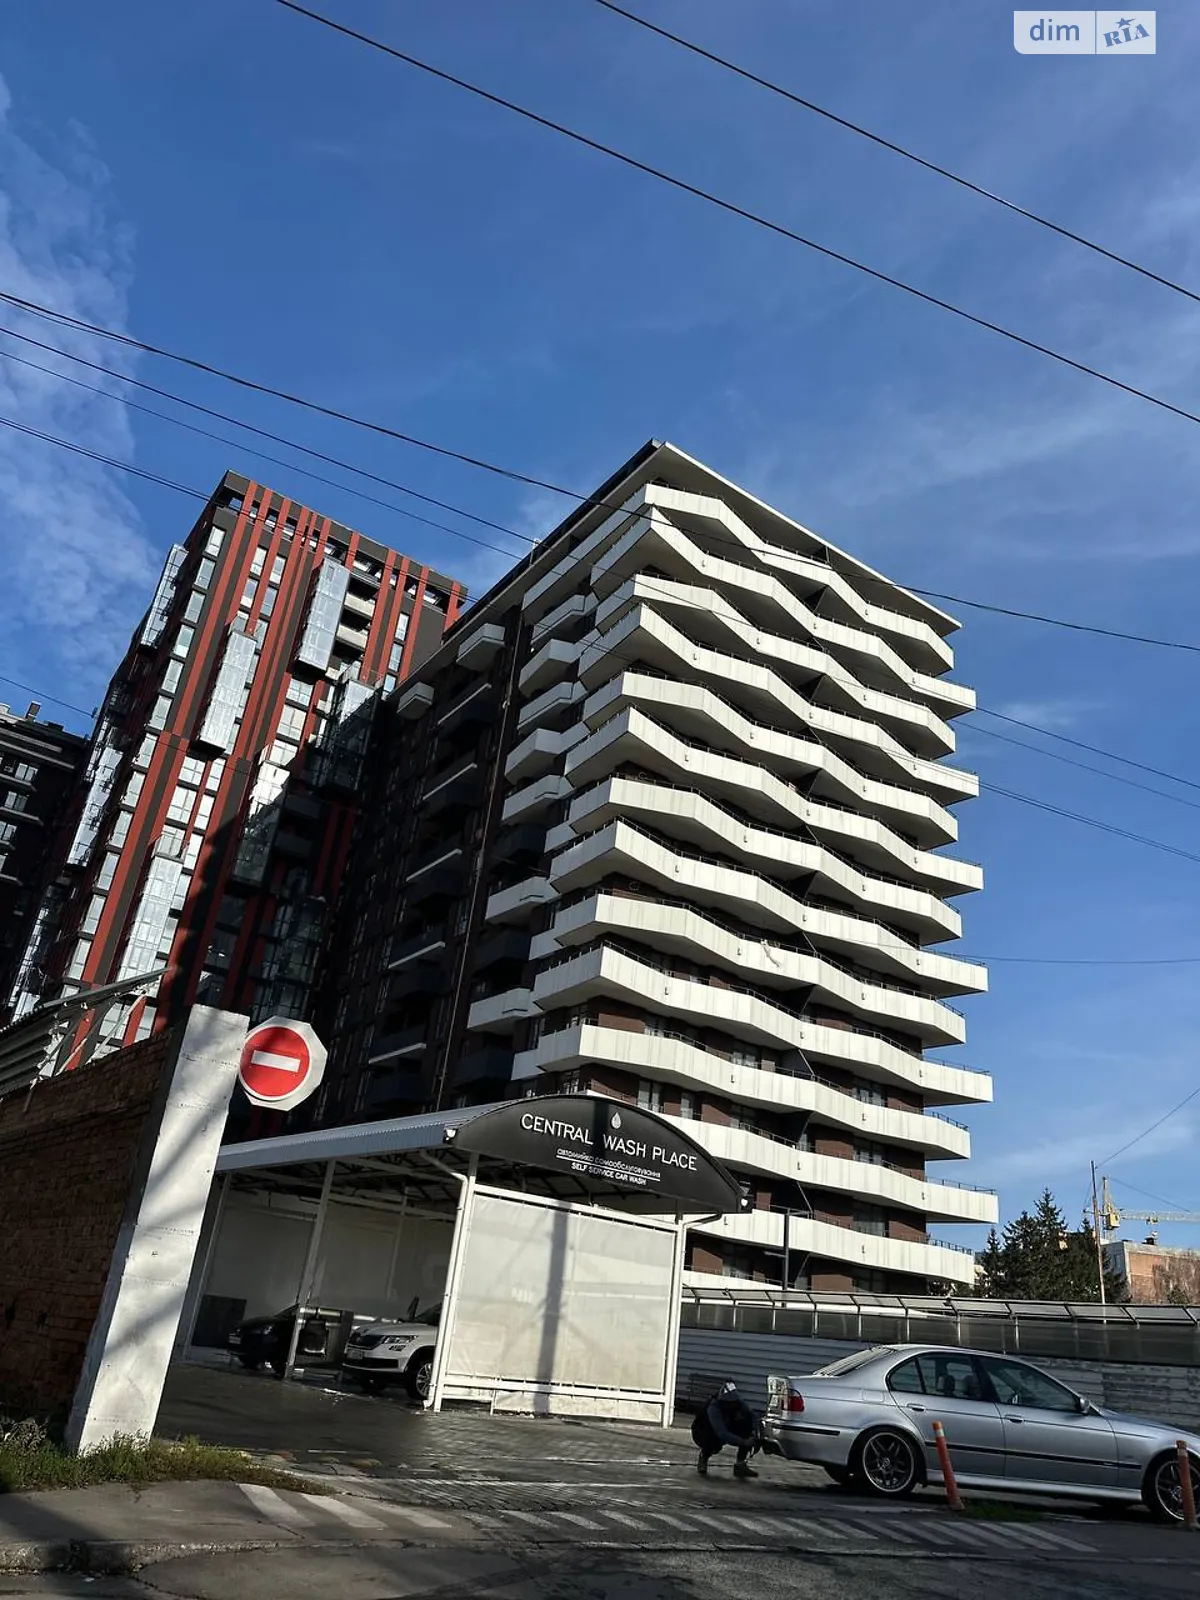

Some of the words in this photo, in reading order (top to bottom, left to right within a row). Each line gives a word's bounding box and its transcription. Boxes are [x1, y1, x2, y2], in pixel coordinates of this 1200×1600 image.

[521, 1113, 594, 1146] CENTRAL
[603, 1133, 646, 1159] WASH
[652, 1146, 698, 1171] PLACE
[571, 1162, 588, 1173] SELF
[588, 1165, 614, 1179] SERVICE
[615, 1172, 628, 1181] CAR
[629, 1175, 647, 1186] WASH
